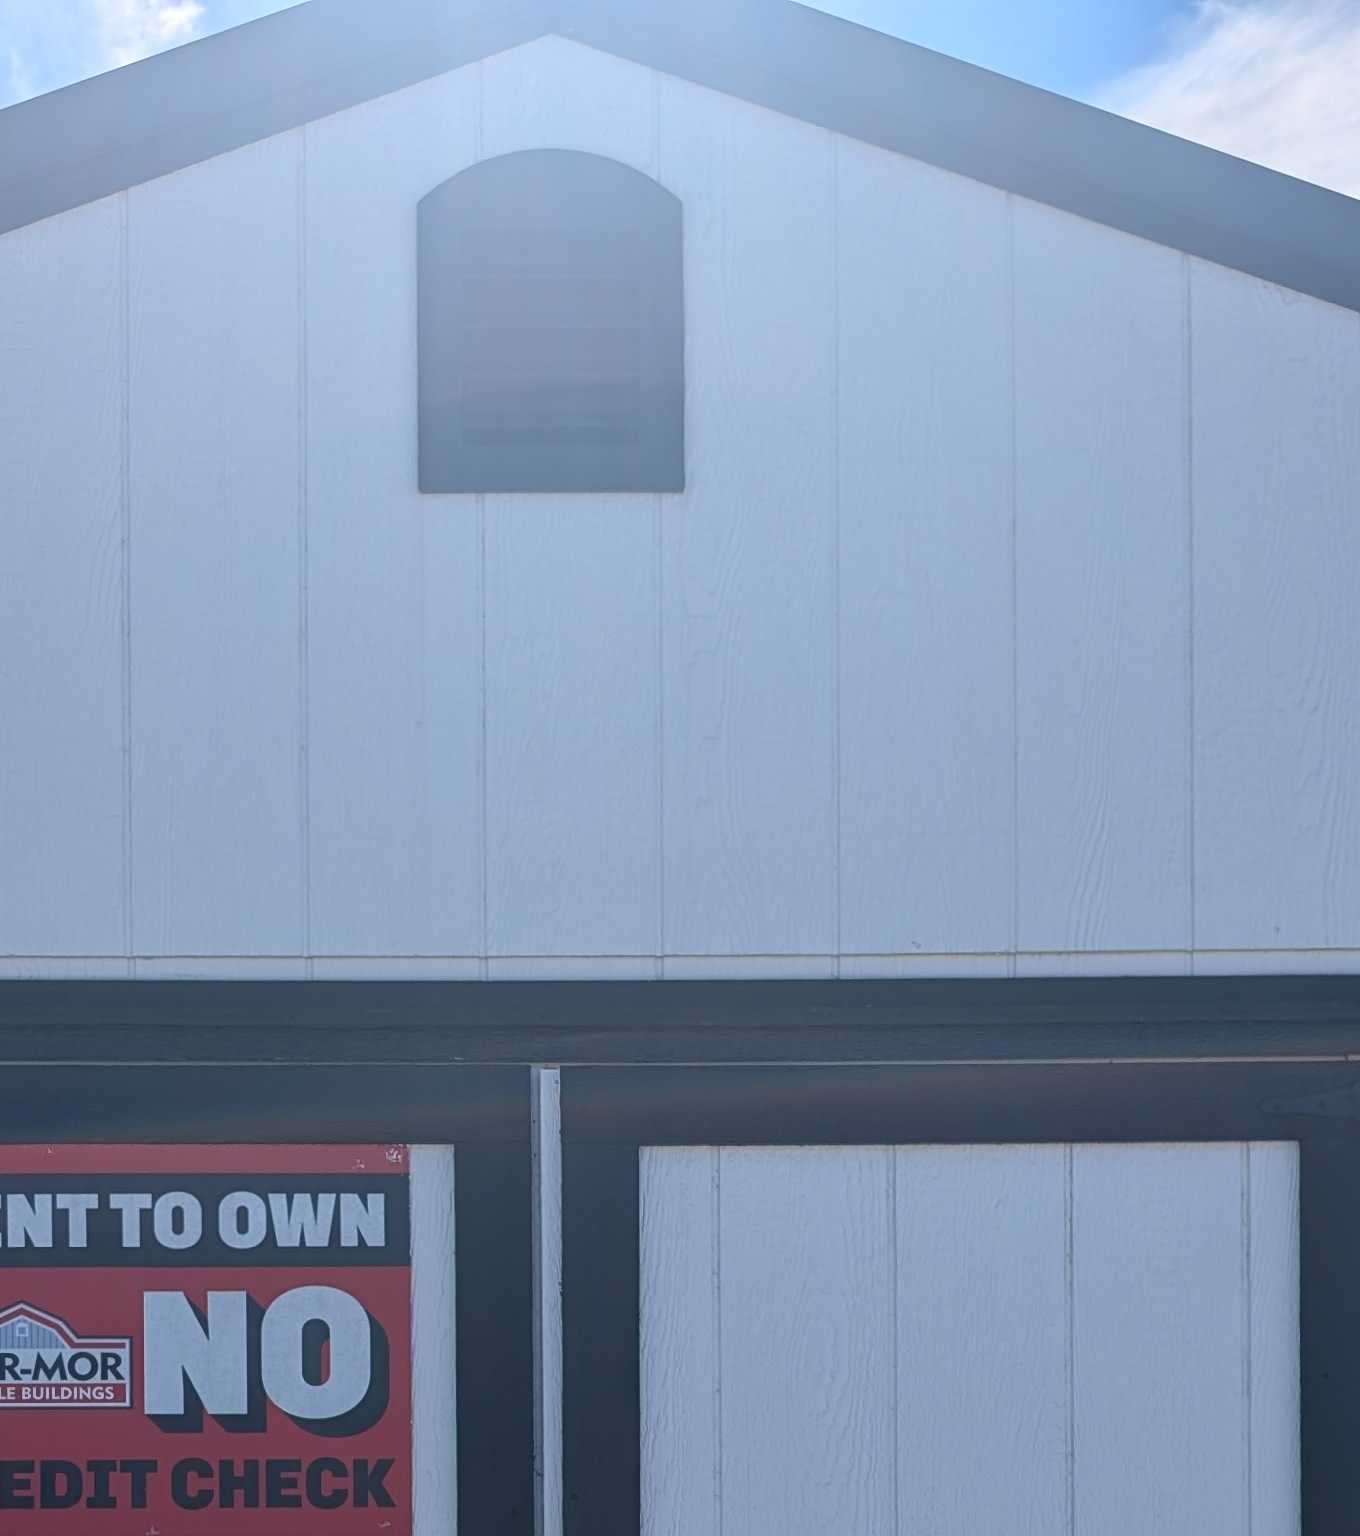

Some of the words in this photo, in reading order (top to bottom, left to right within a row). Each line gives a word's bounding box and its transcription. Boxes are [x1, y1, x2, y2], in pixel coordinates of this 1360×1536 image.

[109, 1191, 203, 1250] TO
[218, 1191, 386, 1250] OWN
[143, 1285, 373, 1421] NO
[21, 1386, 115, 1401] BUILDINGS
[171, 1457, 396, 1511] CHECK
